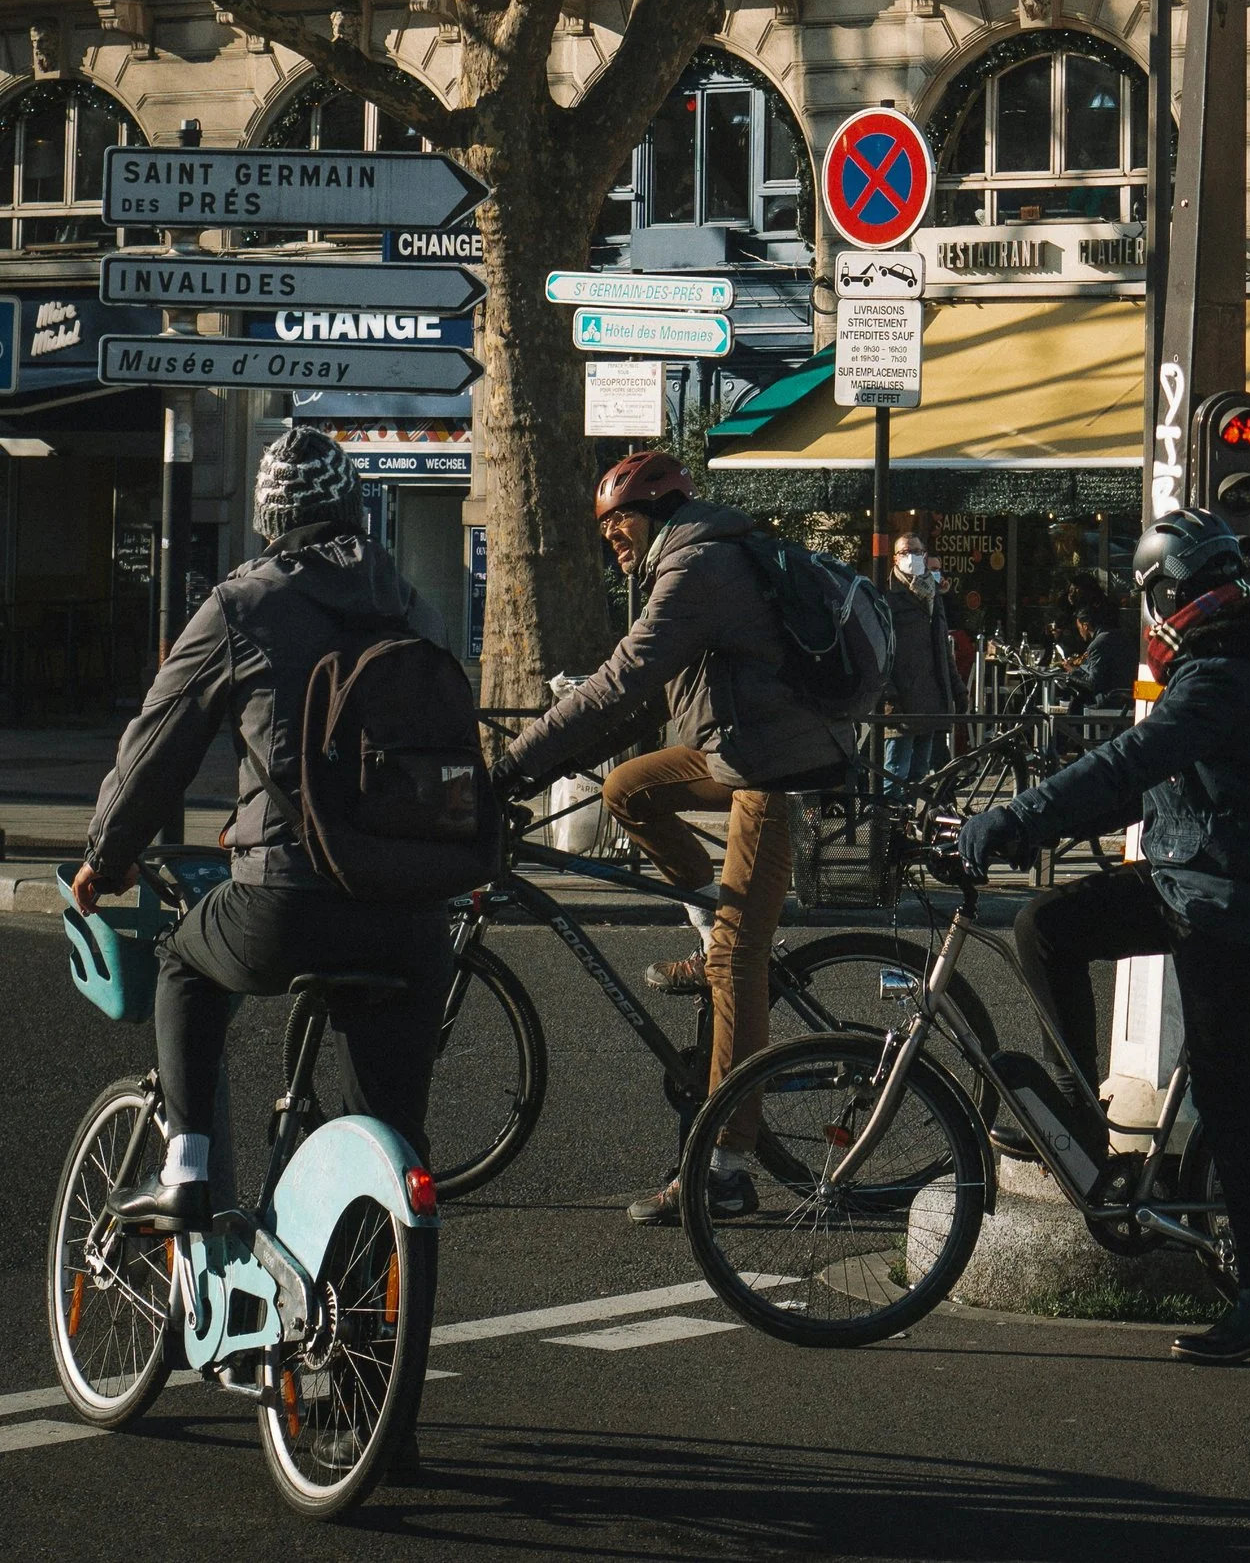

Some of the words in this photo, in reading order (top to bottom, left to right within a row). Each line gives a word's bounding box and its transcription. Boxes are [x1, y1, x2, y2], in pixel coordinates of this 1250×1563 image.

[123, 160, 213, 185] SAINT
[235, 163, 375, 188] GERMAIN
[121, 198, 159, 213] DES
[178, 188, 262, 215] PRÉS
[398, 232, 483, 258] CHANGE
[936, 240, 1045, 269] RESTAURANT
[1078, 237, 1145, 266] GLACIER
[120, 269, 296, 296] INVALIDES
[589, 283, 704, 302] GERMAIN-DES-PRÉS
[853, 305, 905, 315] LIVRAISONS
[274, 309, 442, 341] CHANGE
[847, 318, 908, 328] STRICTEMENT
[605, 323, 635, 338] Hôtel
[641, 325, 656, 339] des
[659, 326, 713, 342] Monnaies
[840, 330, 890, 341] INTERDITES
[892, 331, 915, 341] SAUF
[863, 345, 880, 353] 9h30
[888, 346, 908, 354] 16h30
[119, 349, 215, 375] Musée
[890, 355, 908, 363] 7h30
[838, 366, 854, 377] SUR
[855, 367, 918, 378] EMPLACEMENTS
[590, 378, 657, 387] VIDEOPROTECTION
[850, 379, 905, 391] MATERIALISES
[854, 393, 860, 403] A
[861, 392, 876, 403] CET
[877, 393, 901, 404] EFFET
[378, 458, 417, 470] CAMBIO
[426, 458, 467, 470] WECHSEL
[935, 515, 969, 532] SAINS
[974, 515, 988, 532] ET
[935, 535, 1003, 554] ESSENTIELS
[576, 783, 599, 793] PARIS
[551, 916, 644, 1026] ROCKRIDER
